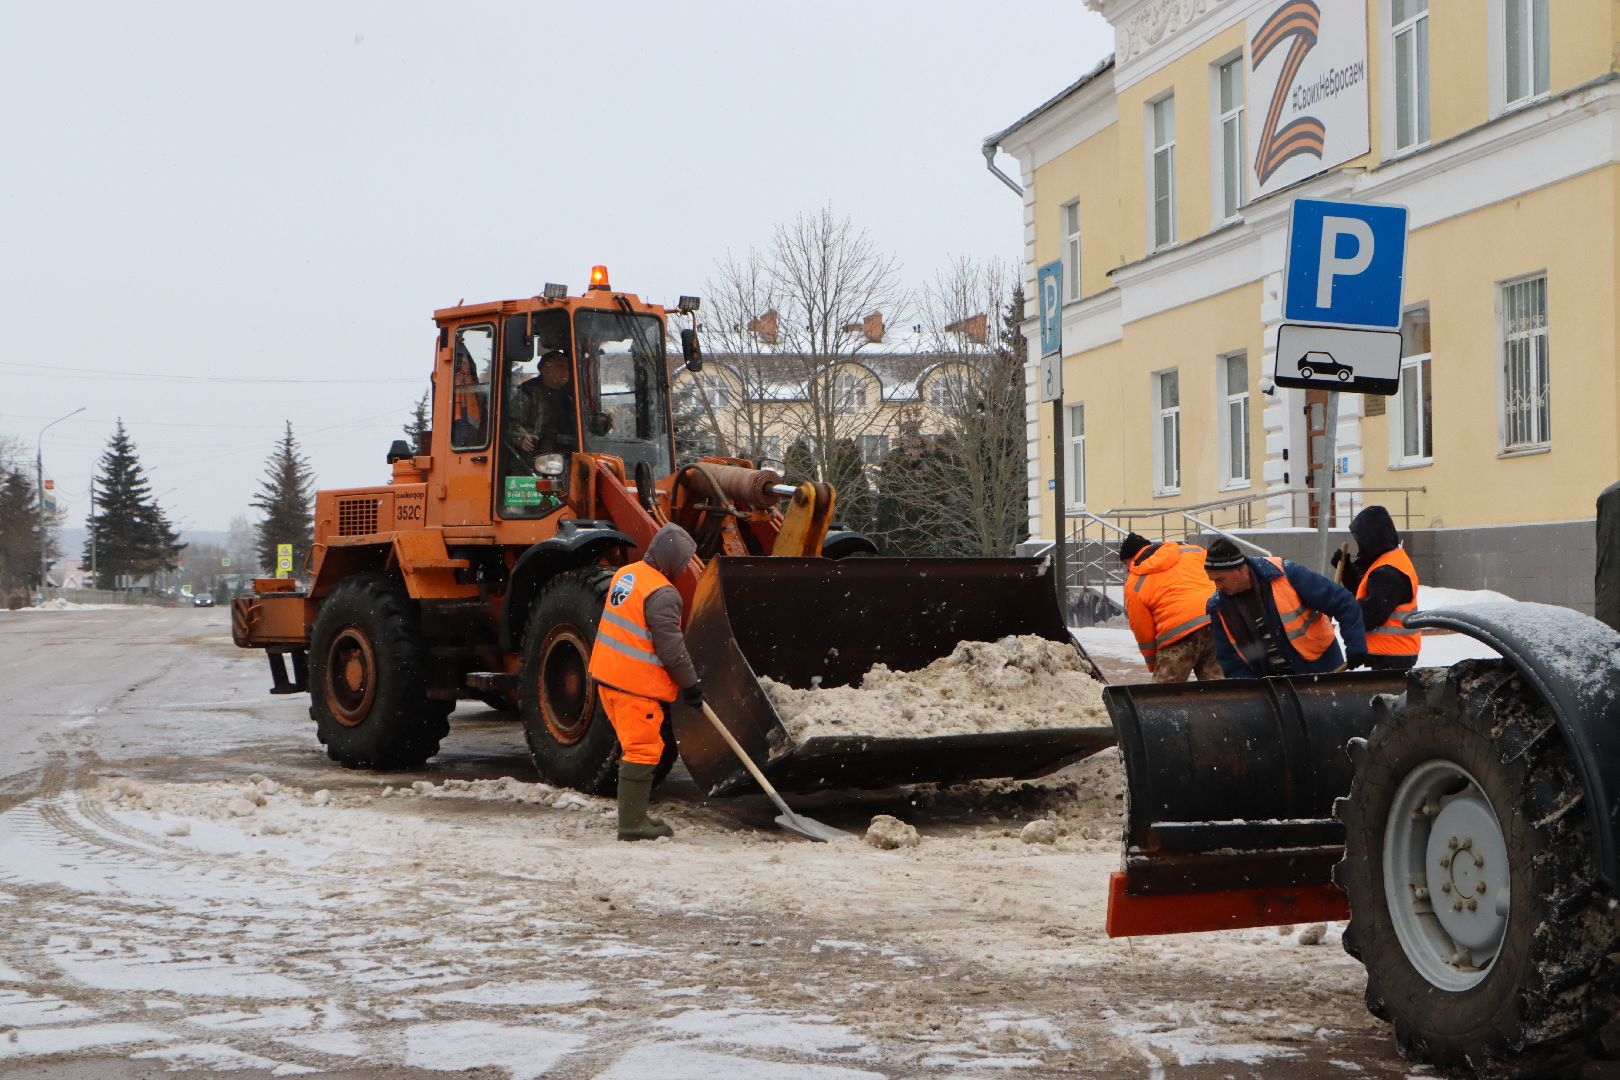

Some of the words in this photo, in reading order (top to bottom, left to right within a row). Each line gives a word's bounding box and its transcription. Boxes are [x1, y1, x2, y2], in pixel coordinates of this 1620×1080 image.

[1251, 0, 1325, 187] Z
[1292, 59, 1364, 113] #СвоихНеБросаем
[1316, 215, 1375, 309] P
[1043, 274, 1058, 344] P
